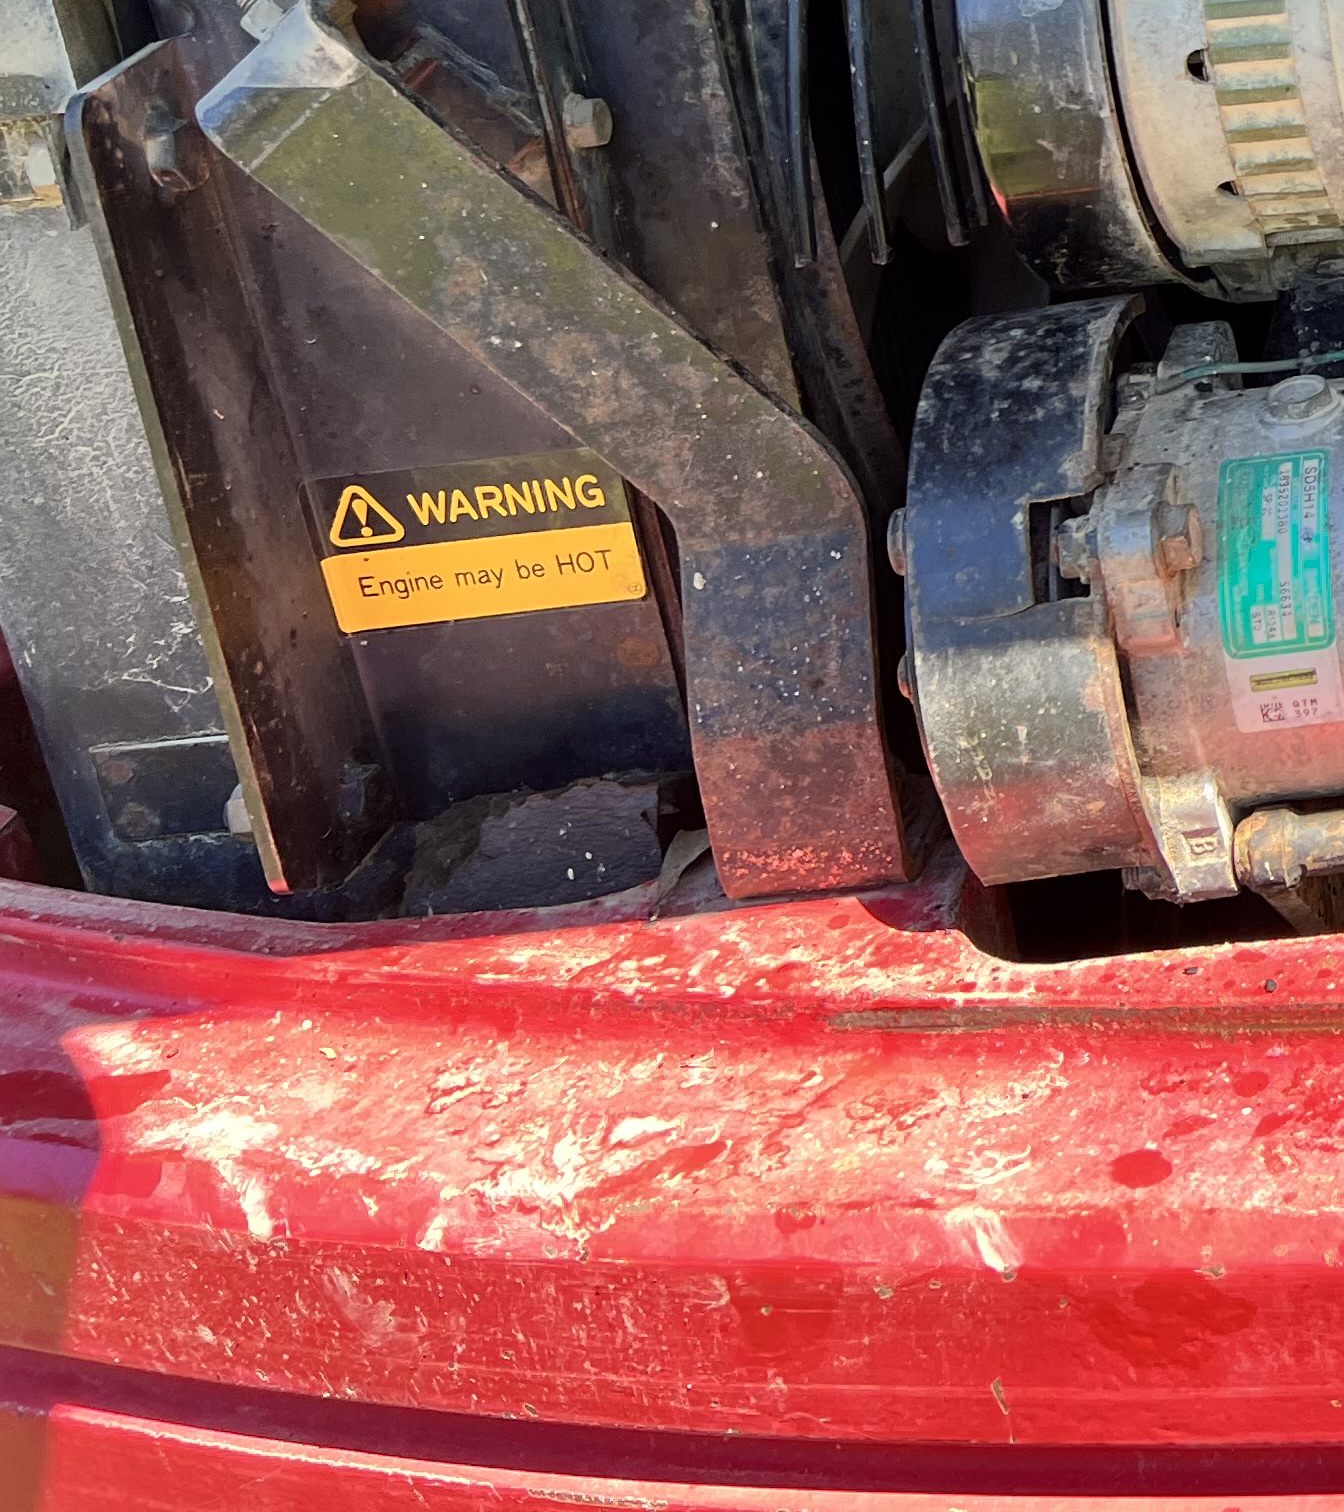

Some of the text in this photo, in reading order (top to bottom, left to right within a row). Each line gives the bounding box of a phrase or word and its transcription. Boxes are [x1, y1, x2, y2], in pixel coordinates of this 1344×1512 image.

[406, 474, 606, 526] WARNING
[1303, 466, 1318, 520] SD5H14
[358, 548, 612, 601] Engine may be HOT
